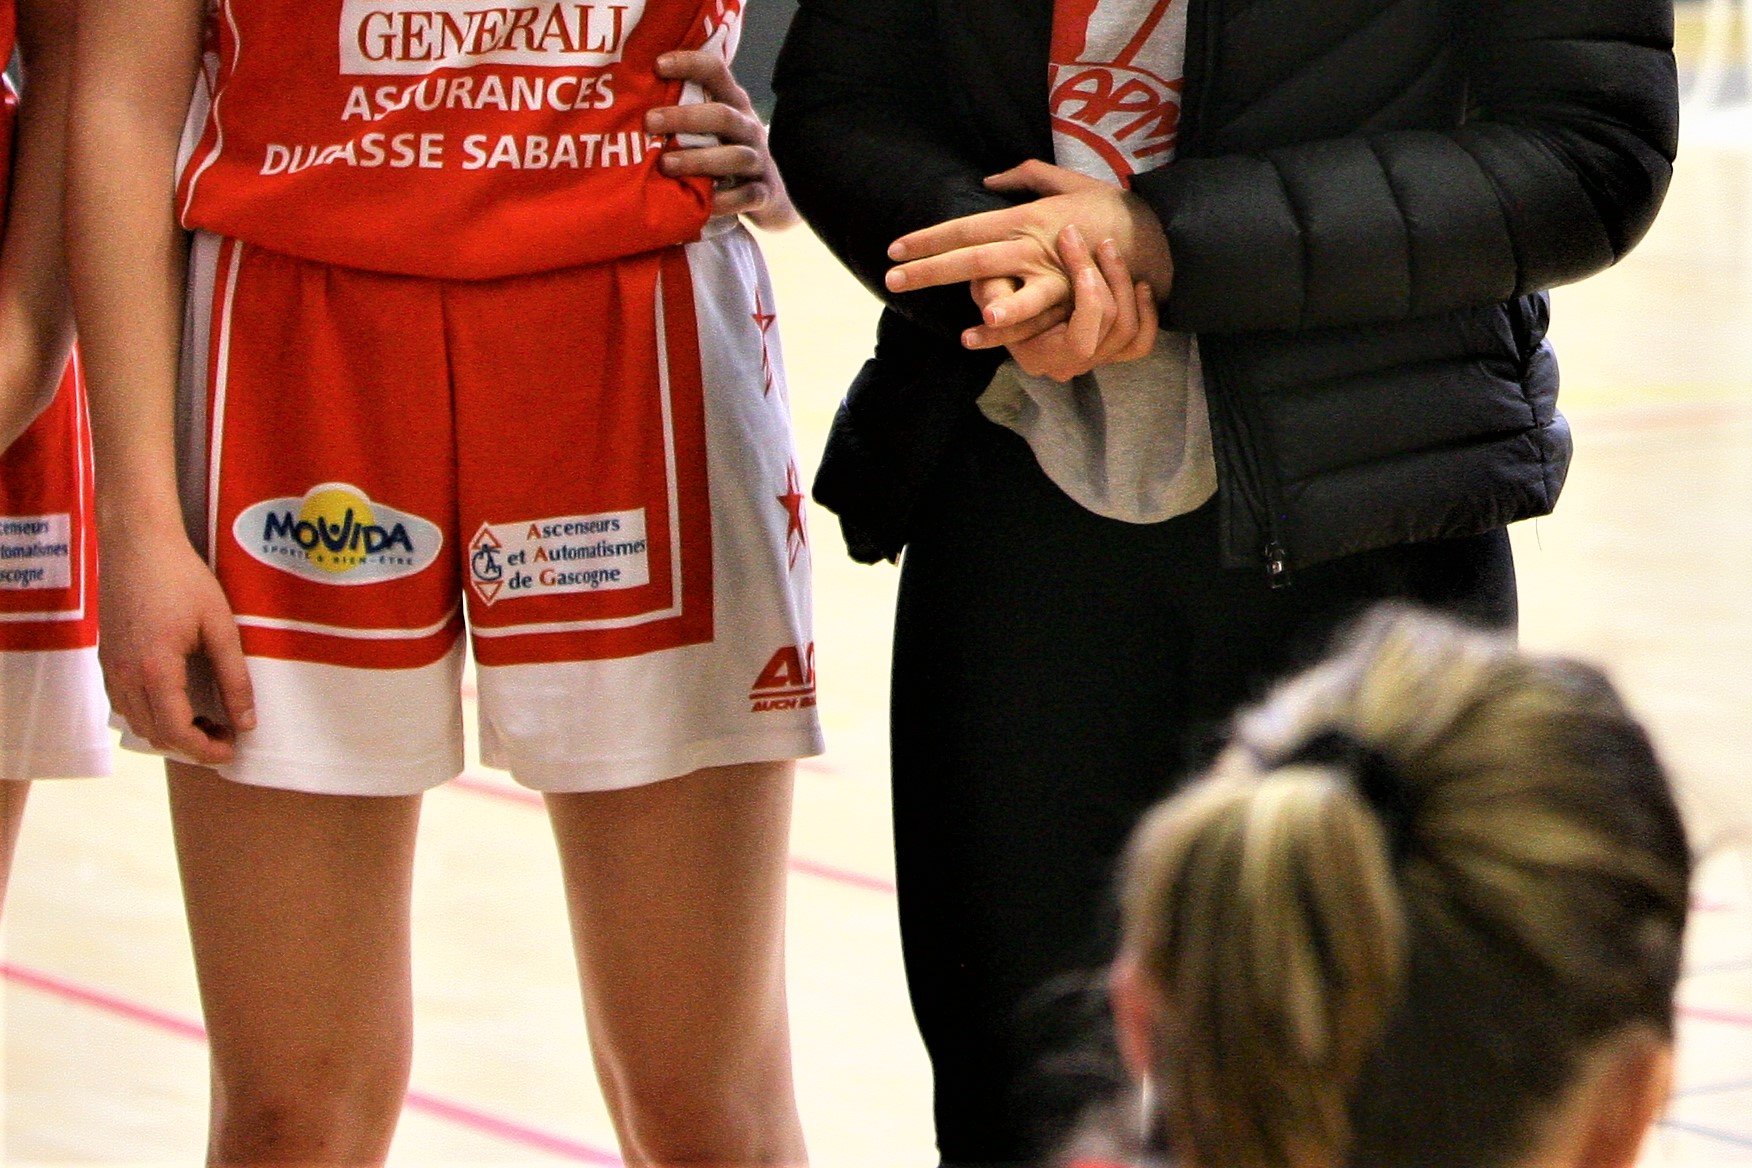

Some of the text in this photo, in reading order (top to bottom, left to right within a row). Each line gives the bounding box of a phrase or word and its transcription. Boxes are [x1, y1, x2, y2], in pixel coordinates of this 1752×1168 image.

[357, 2, 629, 63] GENERALI
[527, 519, 621, 541] Ascenseurs
[507, 550, 526, 566] et
[533, 539, 646, 564] Automatismes
[508, 568, 622, 590] de Gascogne
